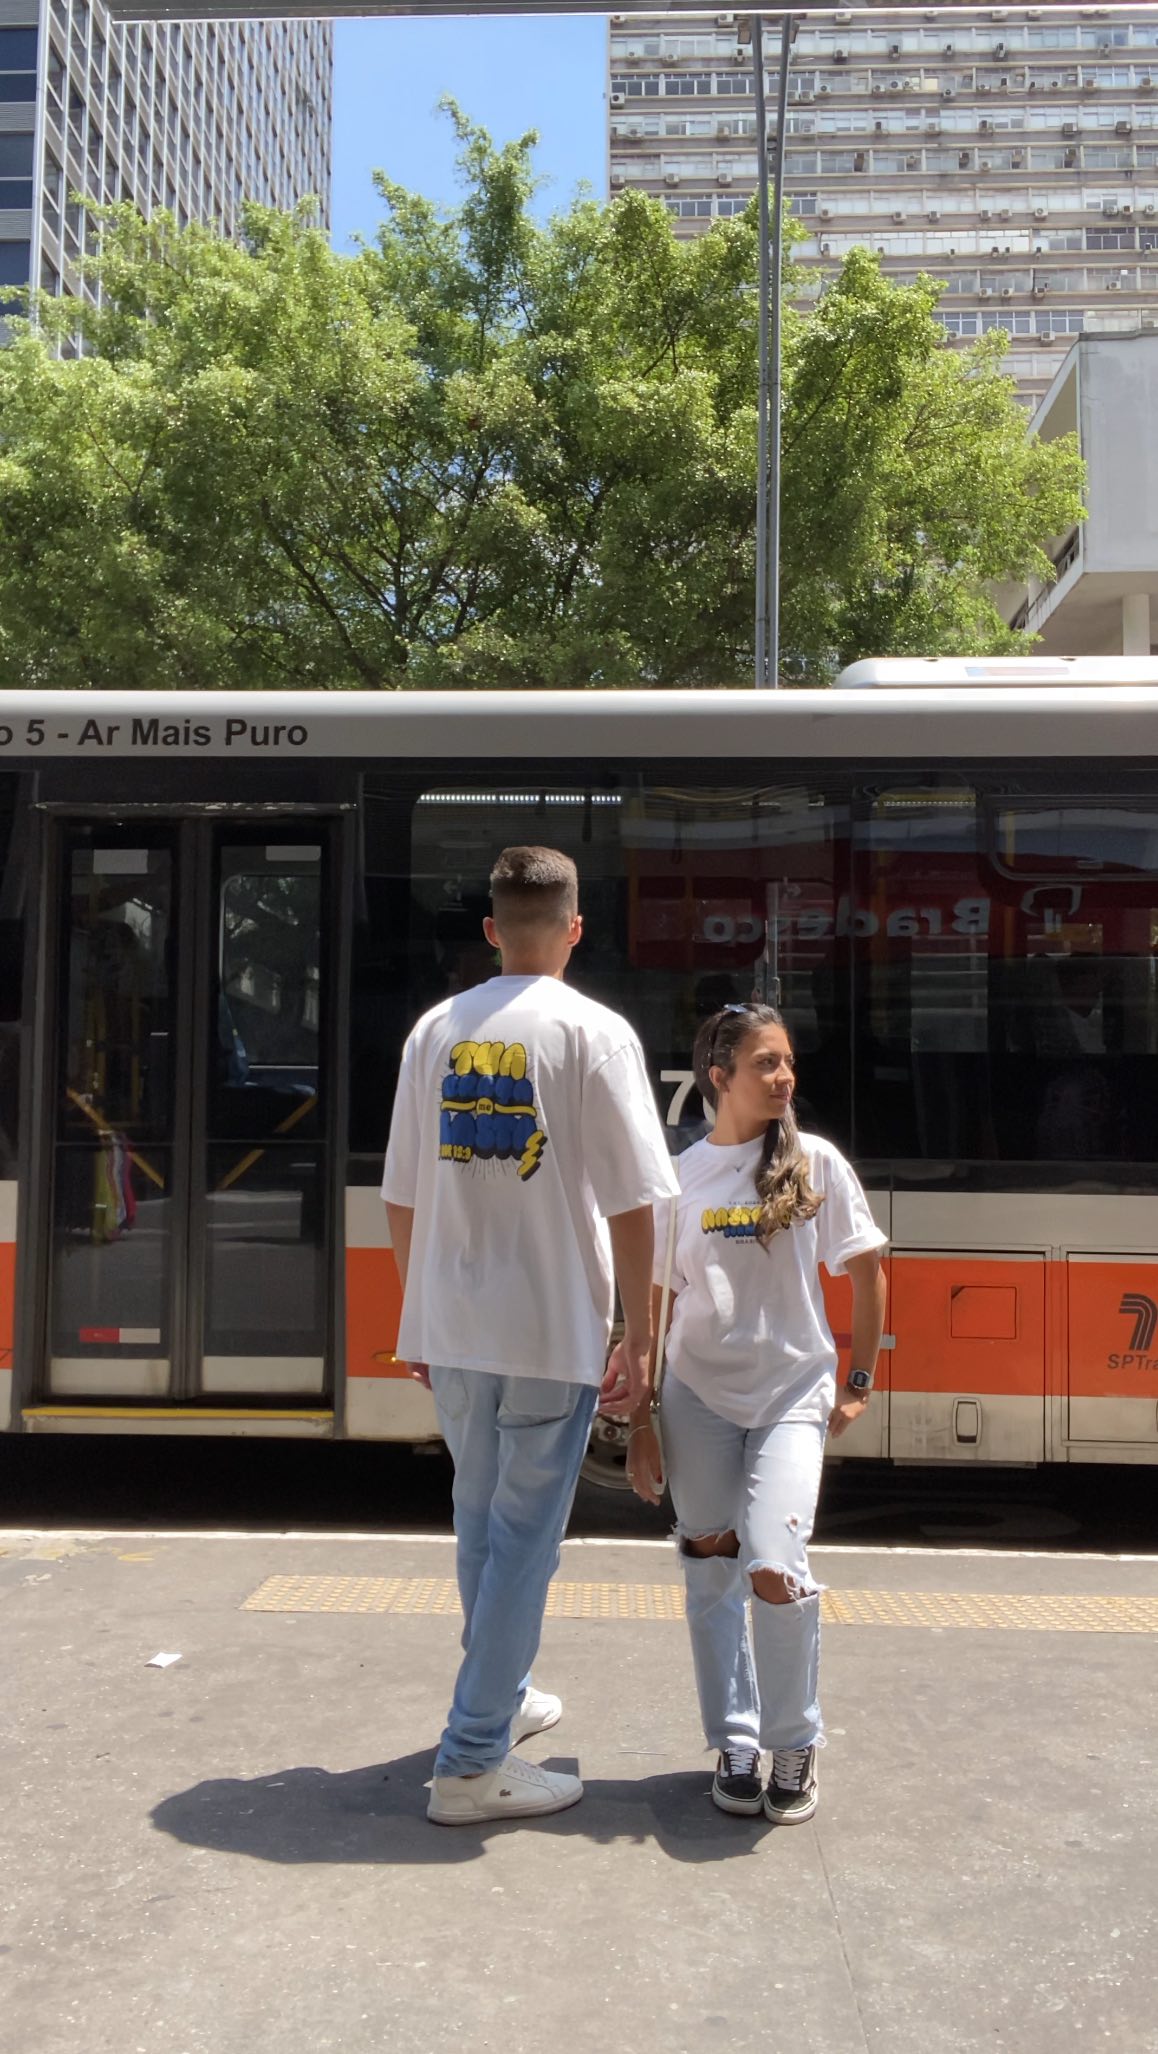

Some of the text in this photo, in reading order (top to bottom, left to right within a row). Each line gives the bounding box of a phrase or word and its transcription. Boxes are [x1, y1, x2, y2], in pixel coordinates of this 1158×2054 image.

[26, 719, 45, 746] 5
[77, 718, 120, 746] Ar
[131, 718, 212, 746] Mais
[225, 718, 309, 746] Puro
